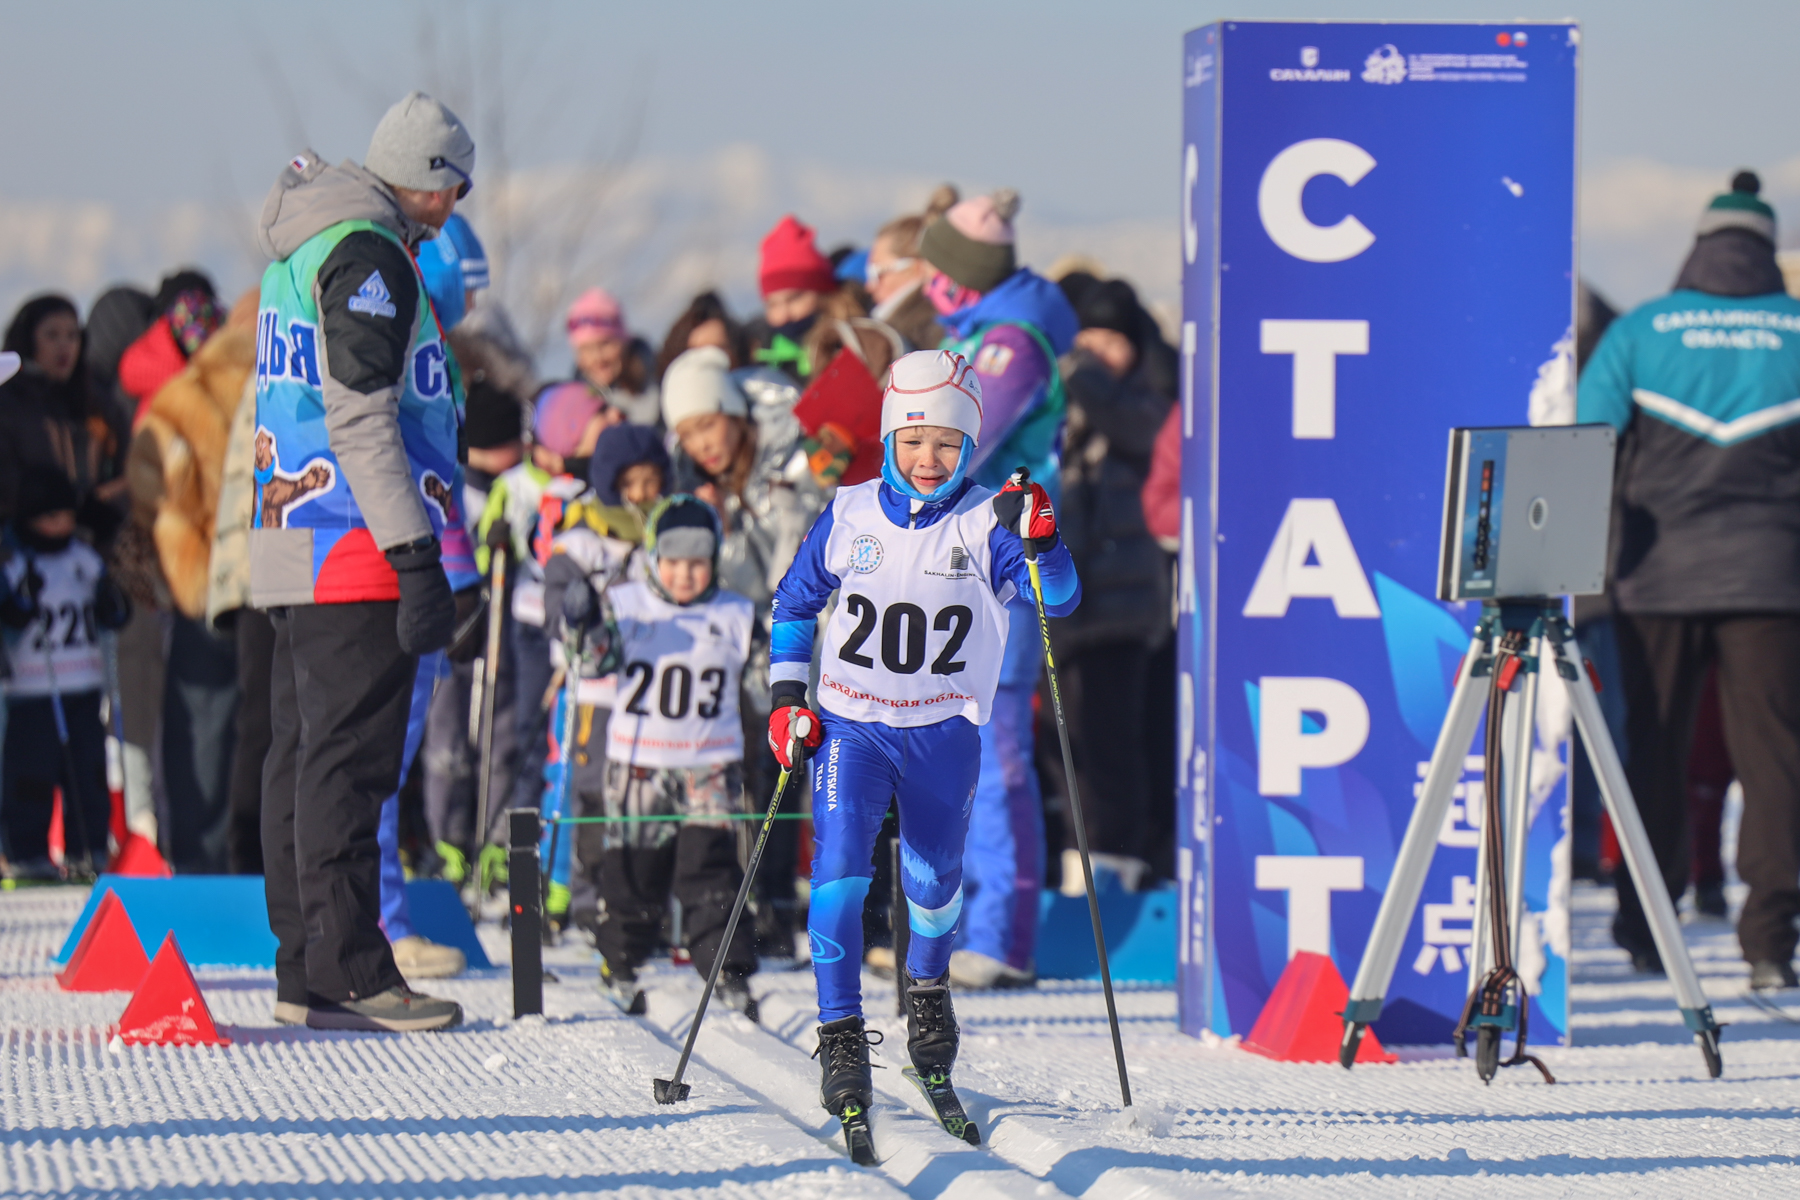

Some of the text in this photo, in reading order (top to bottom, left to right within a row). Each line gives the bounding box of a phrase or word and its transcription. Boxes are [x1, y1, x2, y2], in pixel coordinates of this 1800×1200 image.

[1682, 328, 1783, 350] ОБЛАСТЬ
[1243, 138, 1382, 953] СТАРТ
[838, 593, 973, 676] 202
[625, 660, 726, 719] 203
[822, 673, 977, 708] Сахалинская облас
[815, 763, 824, 792] TEAM
